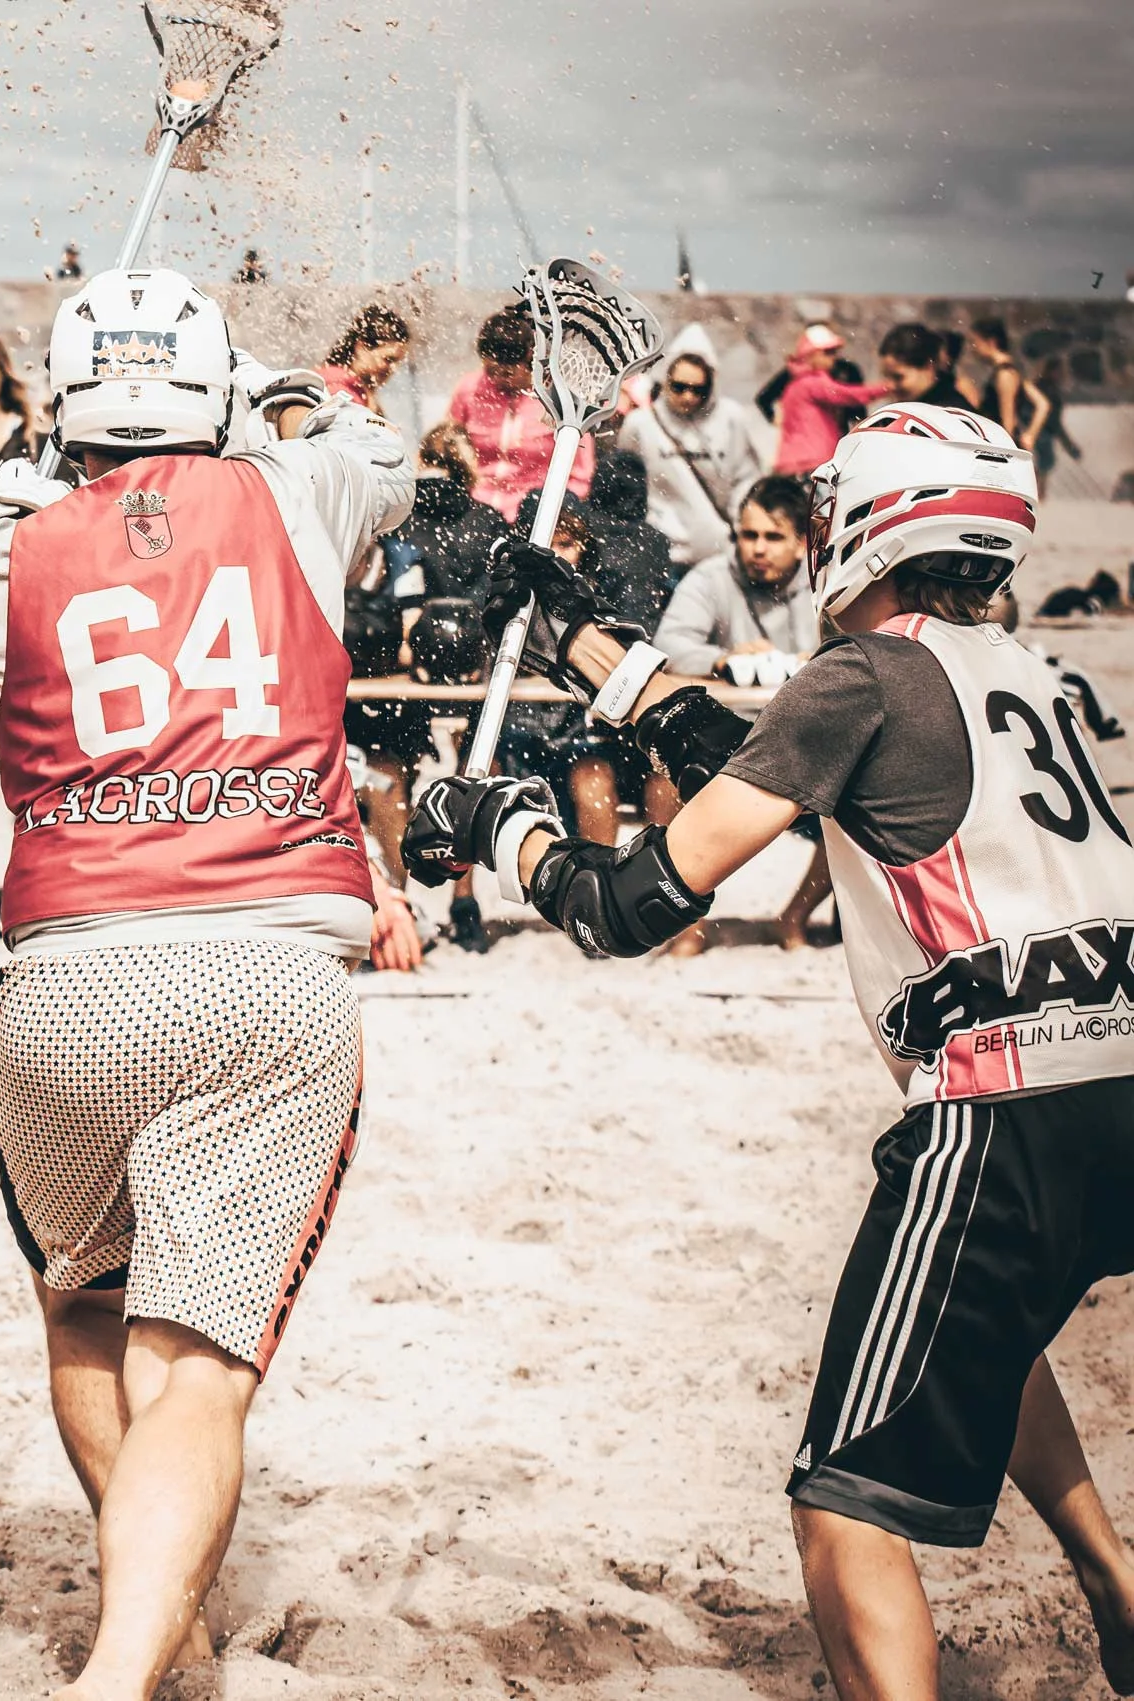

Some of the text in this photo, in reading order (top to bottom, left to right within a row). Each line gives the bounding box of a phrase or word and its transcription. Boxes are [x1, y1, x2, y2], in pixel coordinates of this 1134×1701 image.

[55, 565, 281, 760] 64
[420, 845, 456, 860] STX
[974, 1024, 1053, 1054] BERLIN
